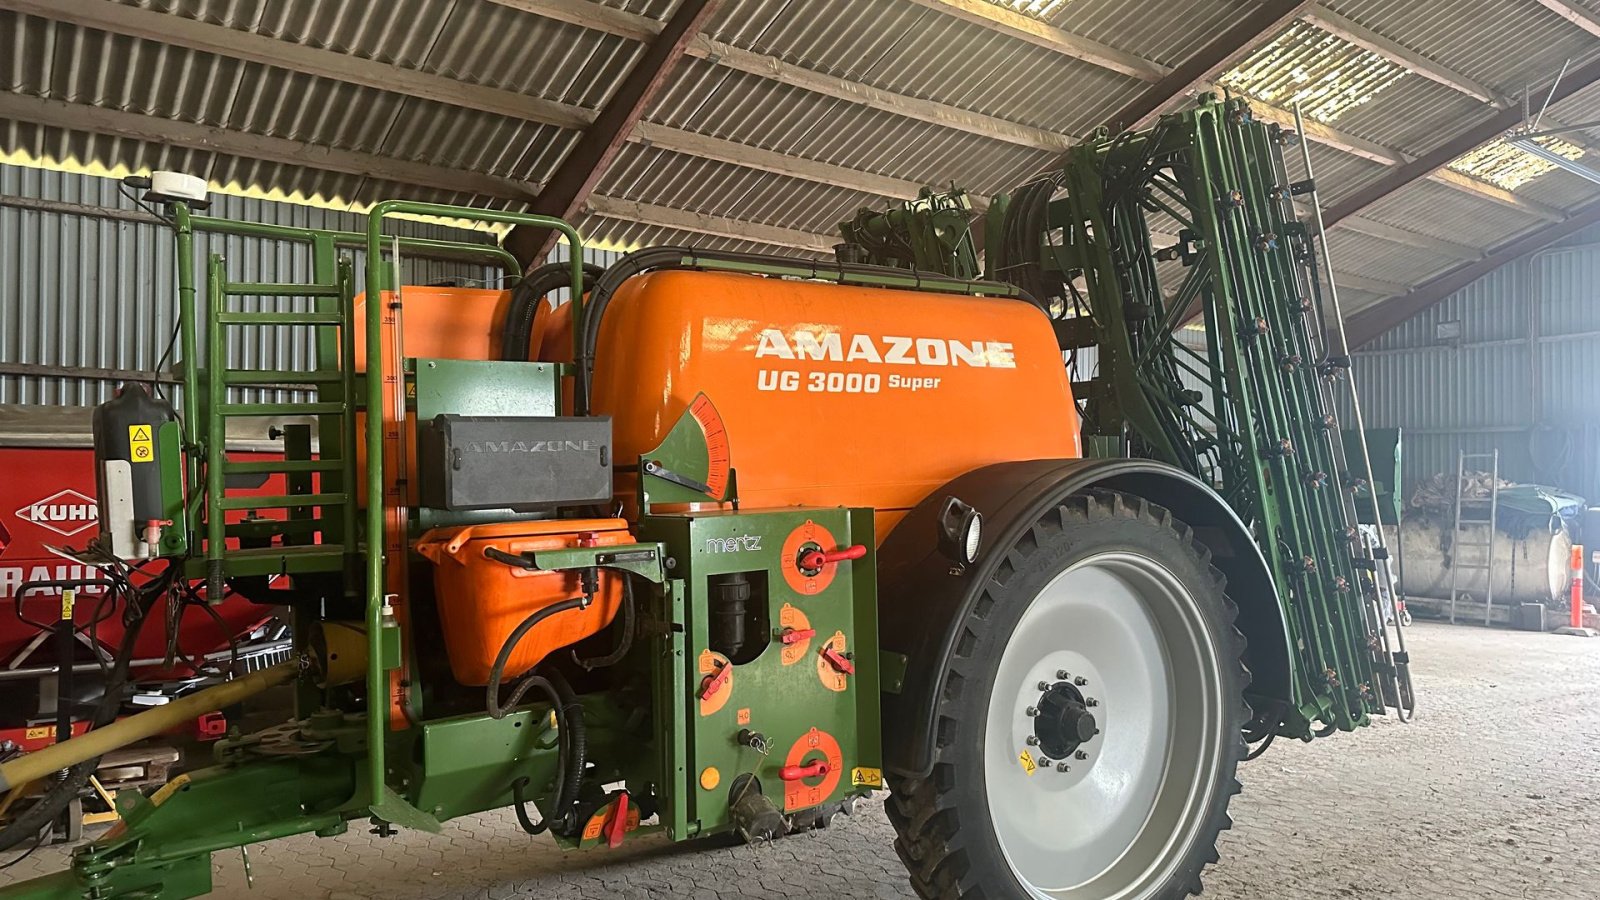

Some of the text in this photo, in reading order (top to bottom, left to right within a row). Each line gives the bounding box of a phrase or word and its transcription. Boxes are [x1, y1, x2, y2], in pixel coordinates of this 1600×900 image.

[755, 328, 1016, 368] AMAZONE
[757, 370, 941, 393] UG 3000 Super
[464, 440, 599, 454] AMAZONE
[706, 534, 762, 554] mertz
